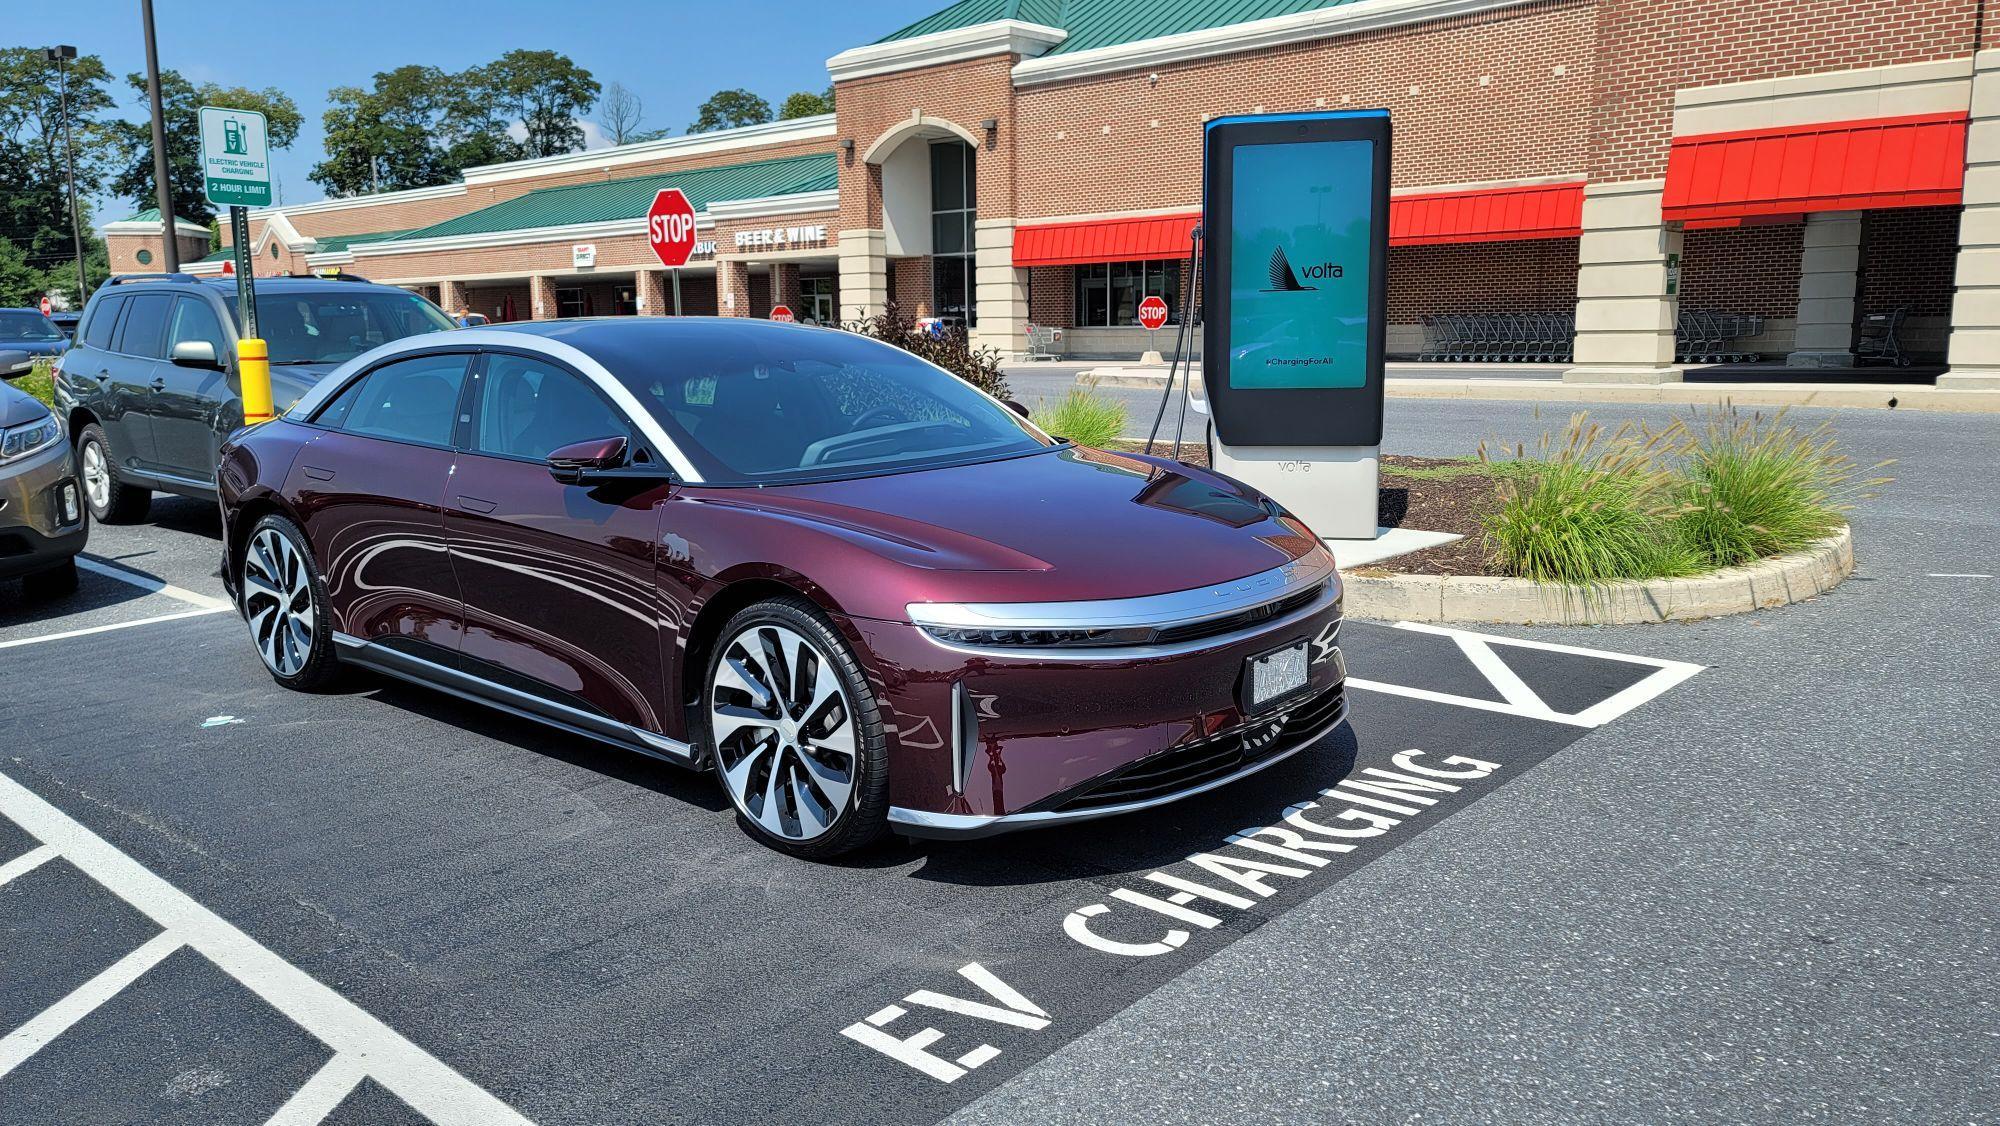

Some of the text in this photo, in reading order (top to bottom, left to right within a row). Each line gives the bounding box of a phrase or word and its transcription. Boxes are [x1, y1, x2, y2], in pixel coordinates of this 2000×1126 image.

[209, 158, 265, 168] ELECTRIC VEHICLE
[222, 167, 254, 175] CHARGING
[211, 182, 266, 194] 2 HOUR LIMIT
[651, 213, 693, 243] STOP
[736, 230, 773, 246] BEER
[787, 225, 828, 242] WINE
[1301, 262, 1343, 278] volta
[1141, 307, 1165, 319] STOP
[840, 749, 1502, 1084] EV CHARGING
